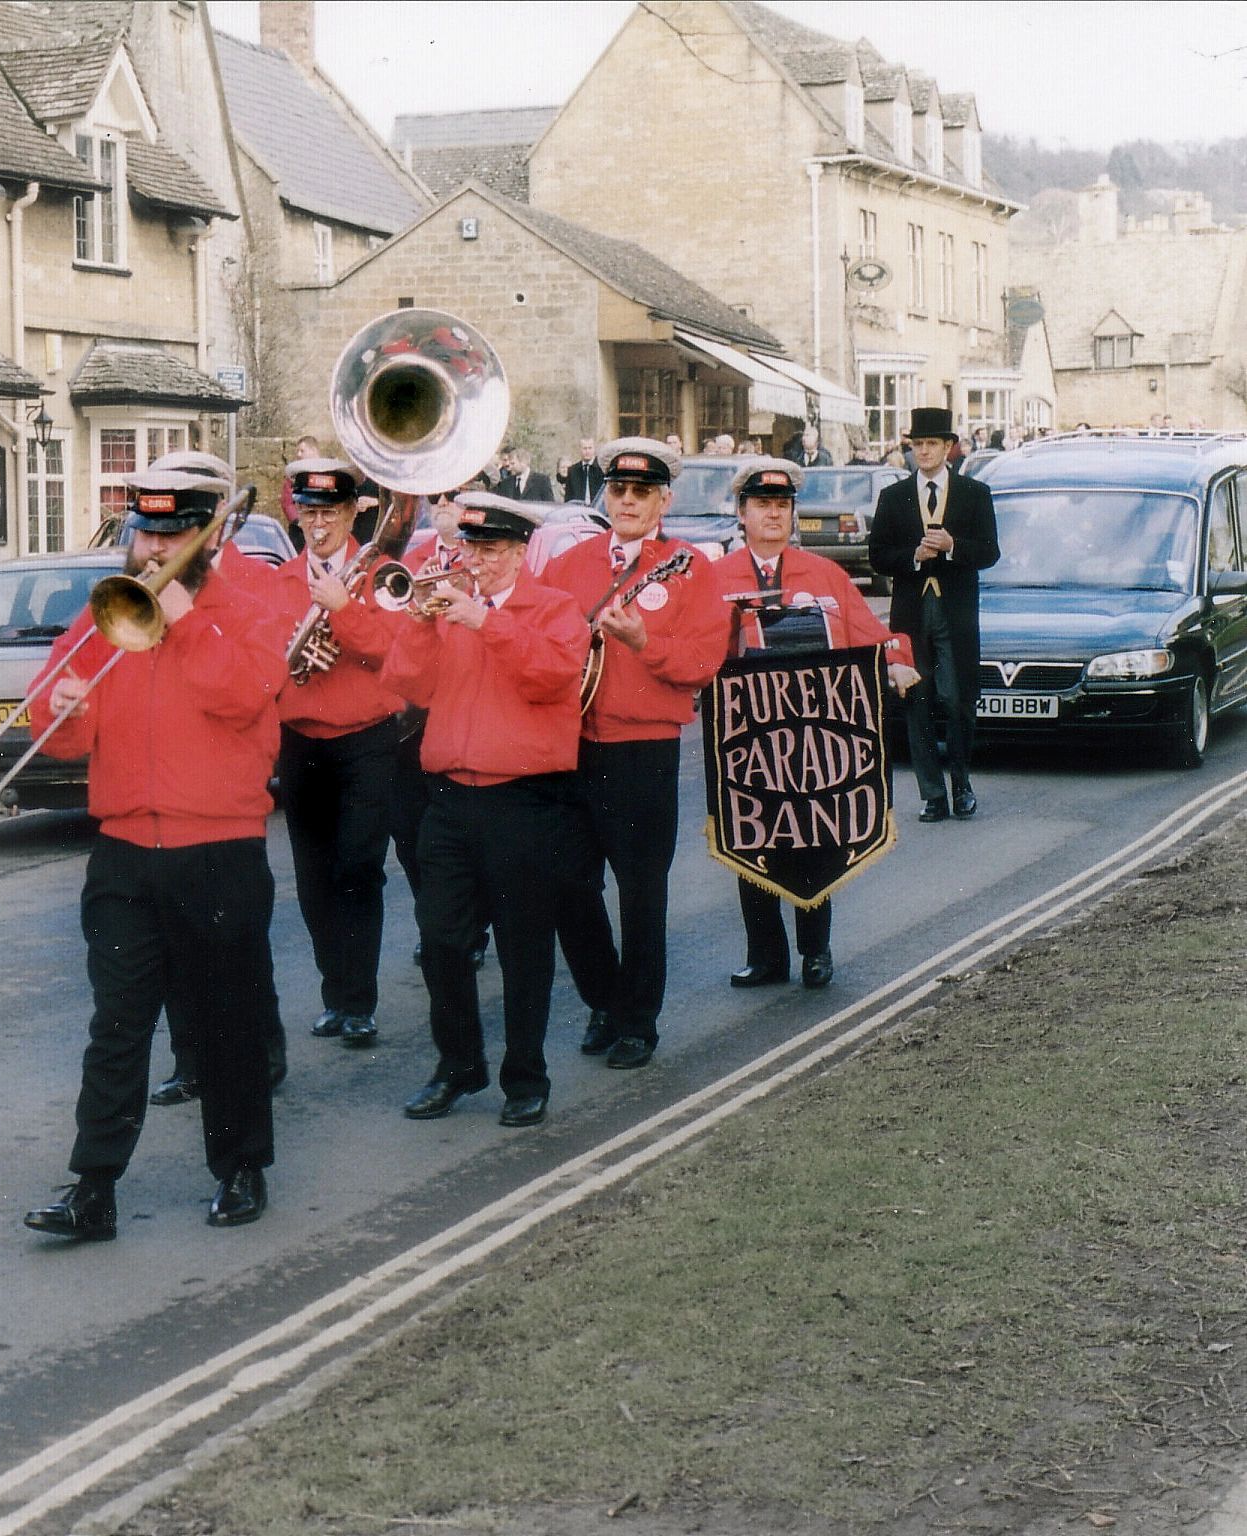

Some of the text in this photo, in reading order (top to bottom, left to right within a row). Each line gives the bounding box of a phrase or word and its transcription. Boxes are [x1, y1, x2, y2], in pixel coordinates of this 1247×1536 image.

[721, 664, 878, 744] EUREKA
[1012, 698, 1051, 714] BBW
[725, 725, 875, 794] PARADE
[728, 784, 877, 850] BAND
